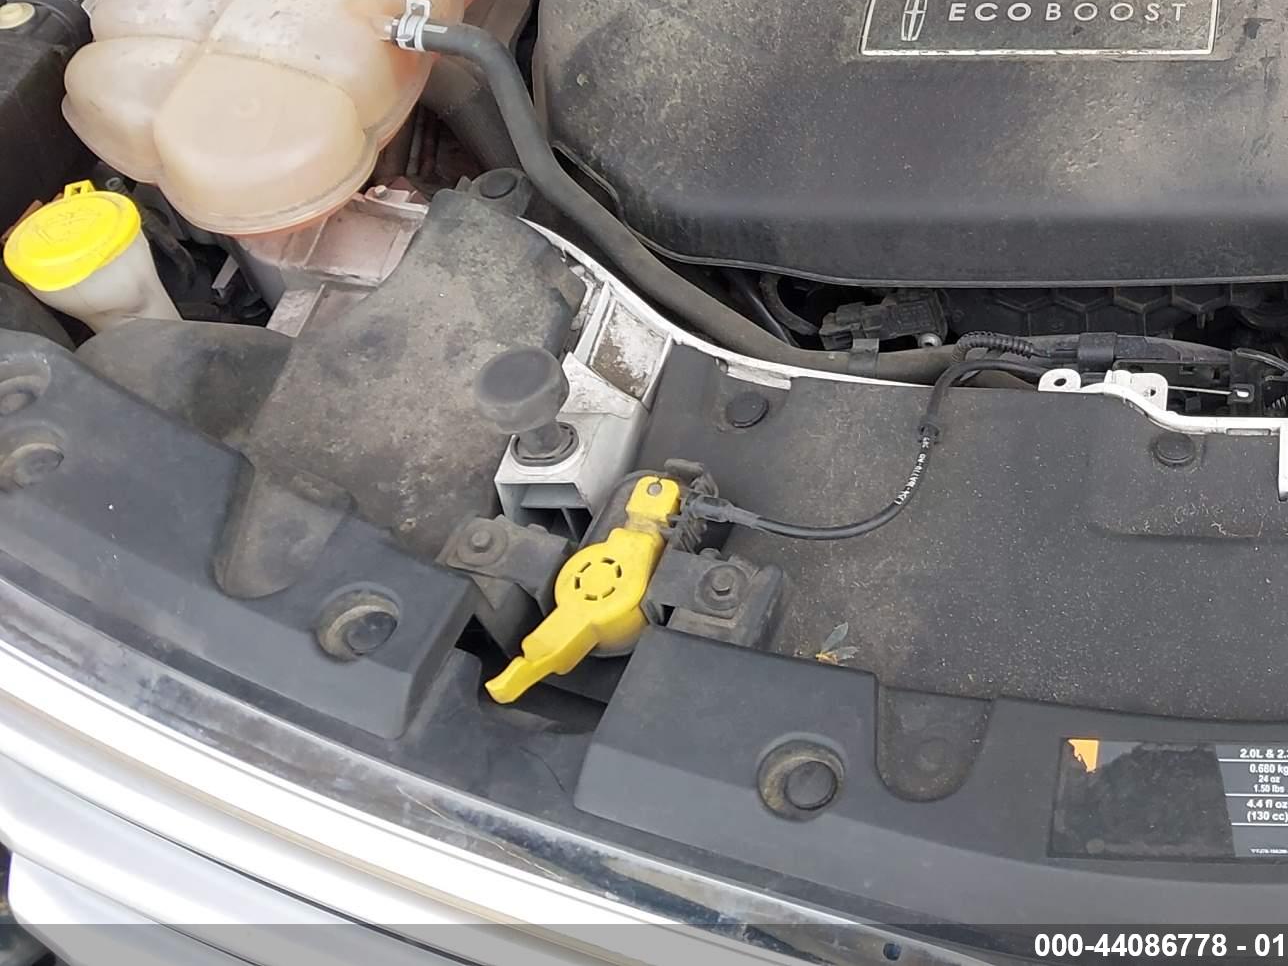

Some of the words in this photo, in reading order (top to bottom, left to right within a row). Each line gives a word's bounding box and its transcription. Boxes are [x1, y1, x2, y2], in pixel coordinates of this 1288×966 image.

[948, 2, 1187, 23] ECOBOOST
[1239, 748, 1264, 759] 2.0L
[1265, 749, 1275, 759] &
[1249, 763, 1276, 774] 0.680
[1258, 775, 1269, 783] 24
[1269, 776, 1281, 784] oz
[1253, 784, 1271, 793] 1.50
[1271, 784, 1286, 793] lbs
[1246, 799, 1264, 809] 4.4
[1265, 799, 1273, 809] fl
[1274, 801, 1288, 809] oz
[1246, 810, 1270, 823] (130
[1271, 811, 1288, 823] cc)
